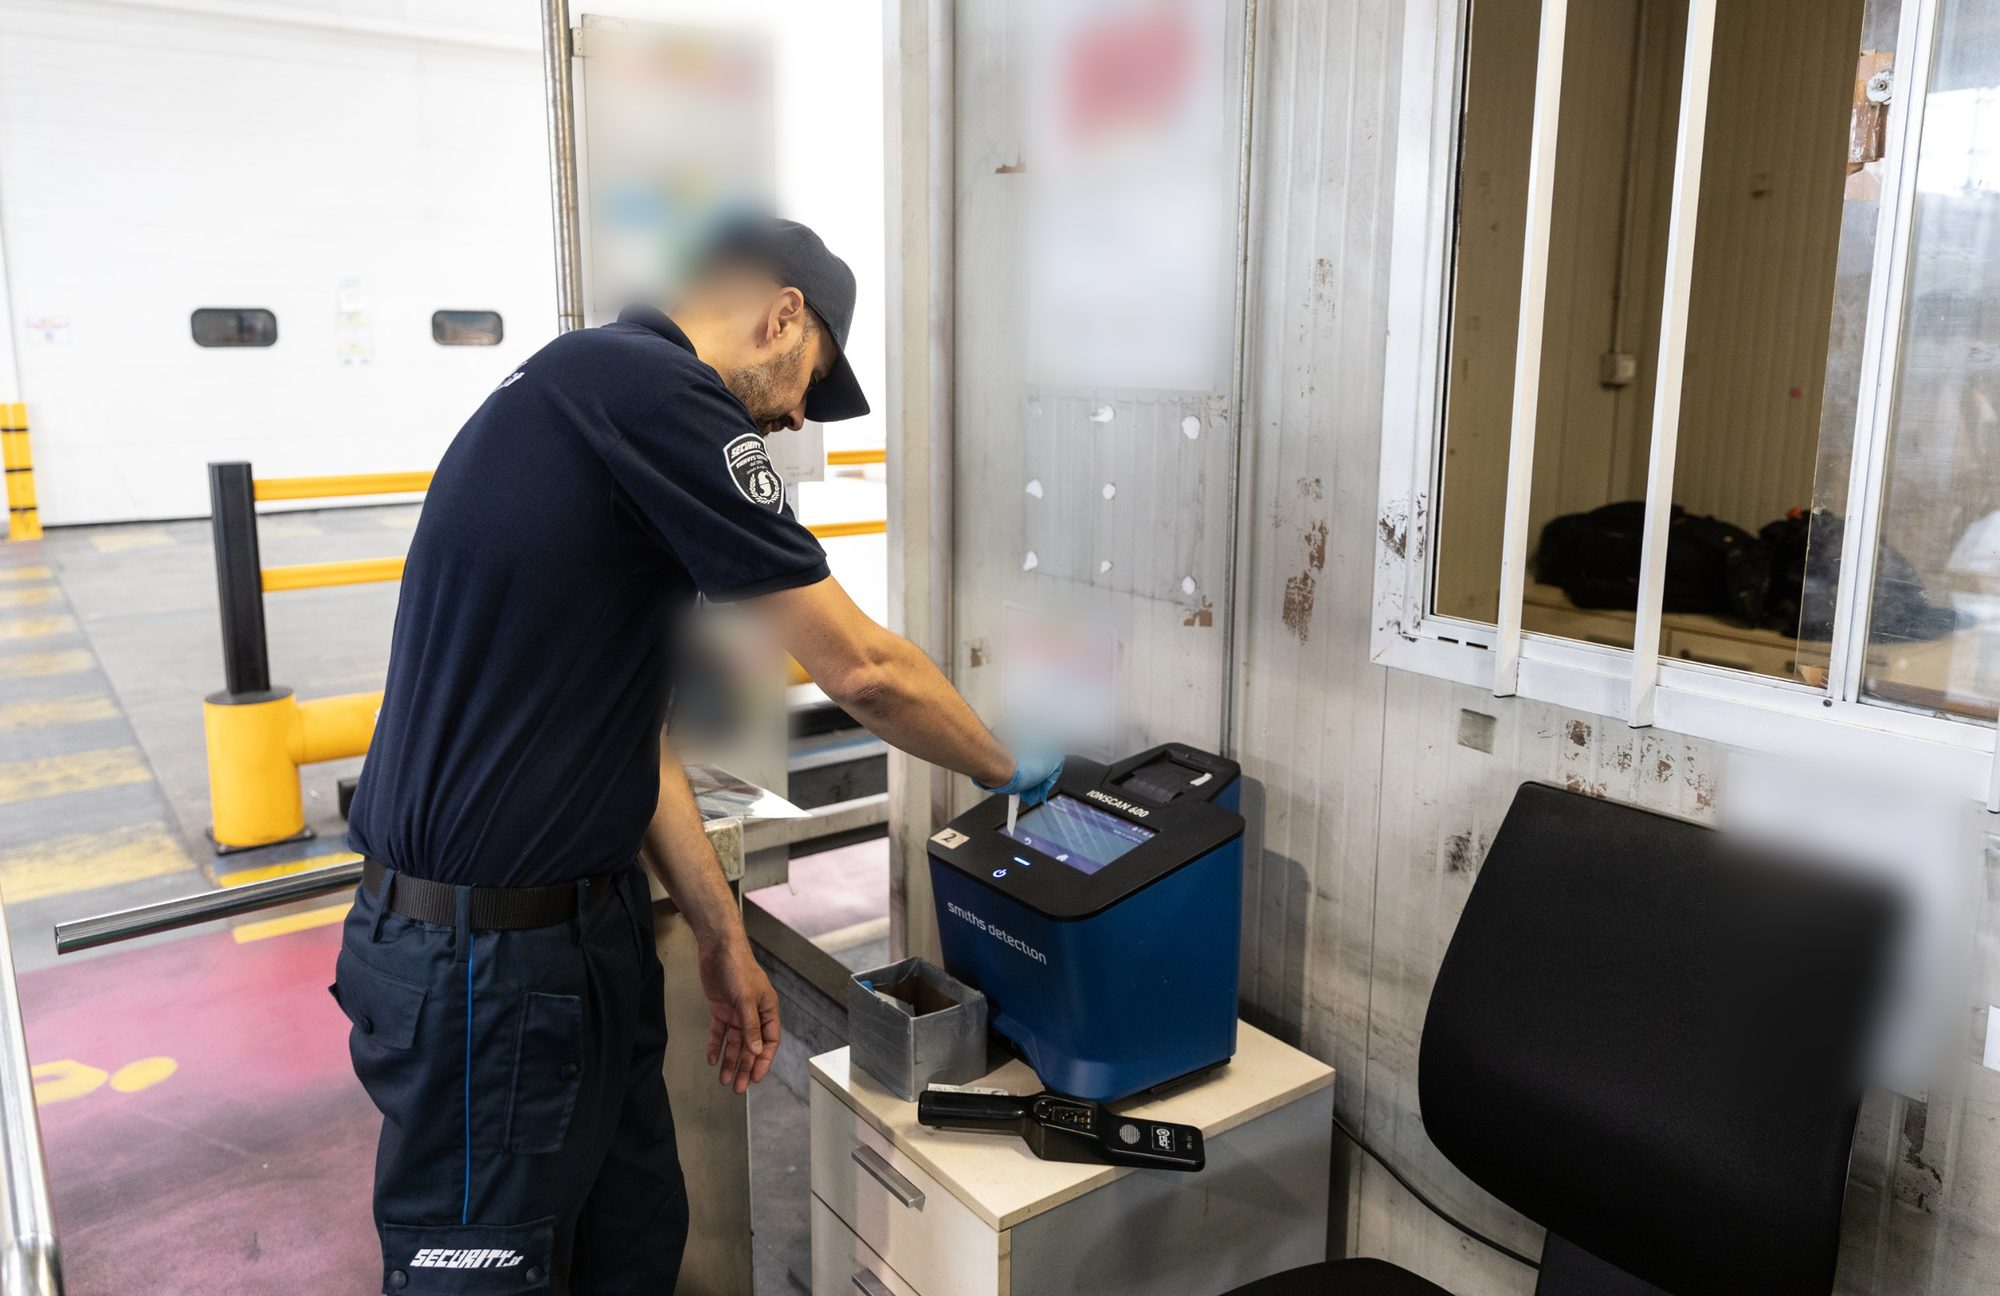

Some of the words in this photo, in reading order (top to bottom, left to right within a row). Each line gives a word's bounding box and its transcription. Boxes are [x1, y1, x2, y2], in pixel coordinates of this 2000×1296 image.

[1086, 789, 1132, 811] IONSCAN
[1128, 805, 1150, 818] 600
[941, 833, 957, 843] 2
[947, 901, 986, 931] smiths
[988, 923, 1047, 965] detection
